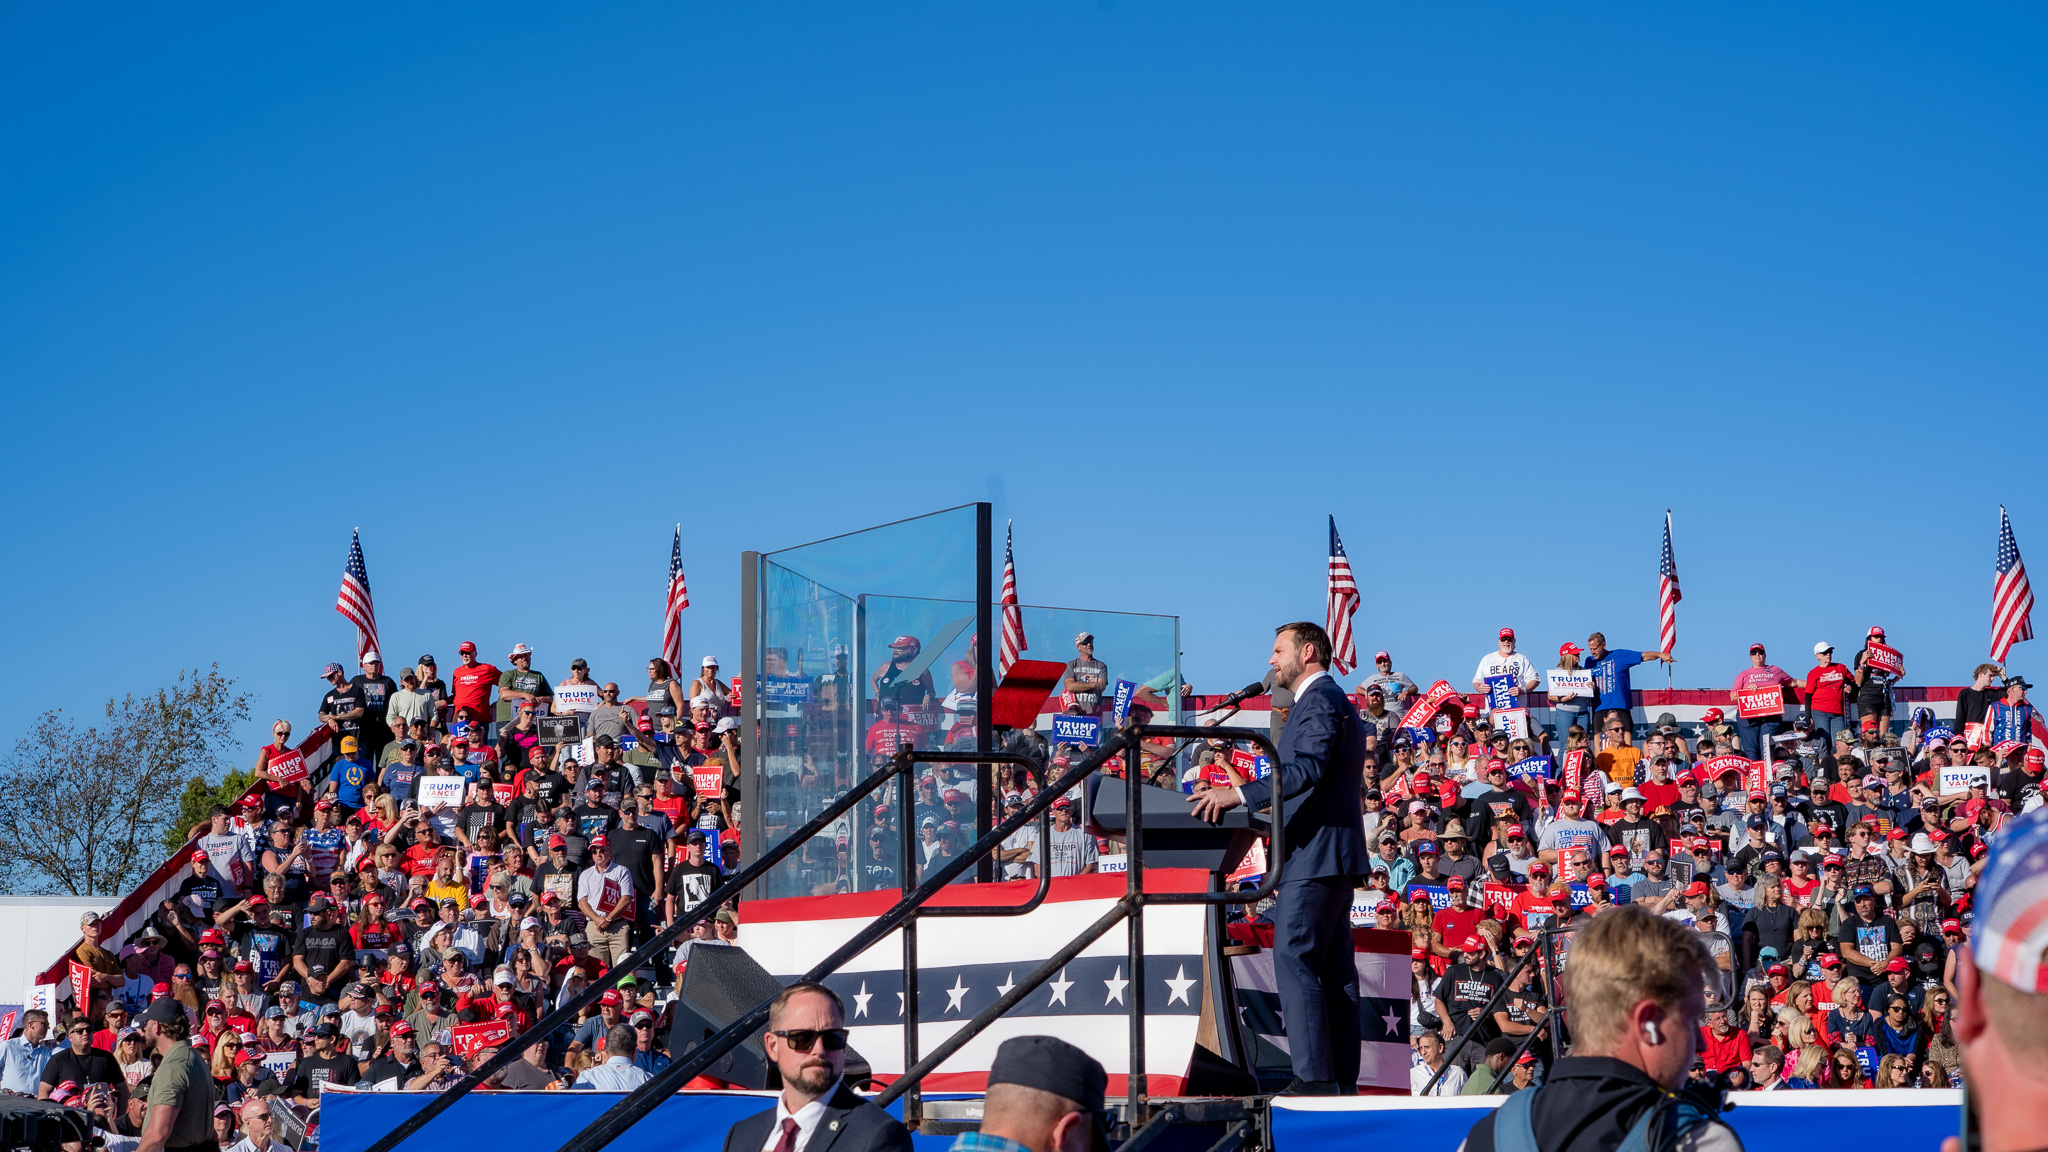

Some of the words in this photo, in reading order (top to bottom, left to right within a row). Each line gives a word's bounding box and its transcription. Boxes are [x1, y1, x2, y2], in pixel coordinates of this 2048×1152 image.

[1499, 676, 1511, 709] TRUM
[1740, 692, 1780, 703] TRUMP
[1745, 700, 1776, 709] VANCE
[514, 705, 546, 717] TMP
[543, 719, 574, 728] NEVER
[1055, 720, 1097, 730] TRUMP
[1059, 729, 1092, 737] VANCE
[1507, 760, 1547, 773] TRUMP
[693, 773, 720, 781] TRUMP
[422, 783, 461, 791] TRUMP
[470, 790, 511, 799] TMP
[206, 840, 233, 849] TRUMP
[1101, 862, 1126, 871] TRU
[305, 937, 336, 946] MAGA
[1457, 982, 1490, 992] TRUMP
[473, 1040, 483, 1050] 45
